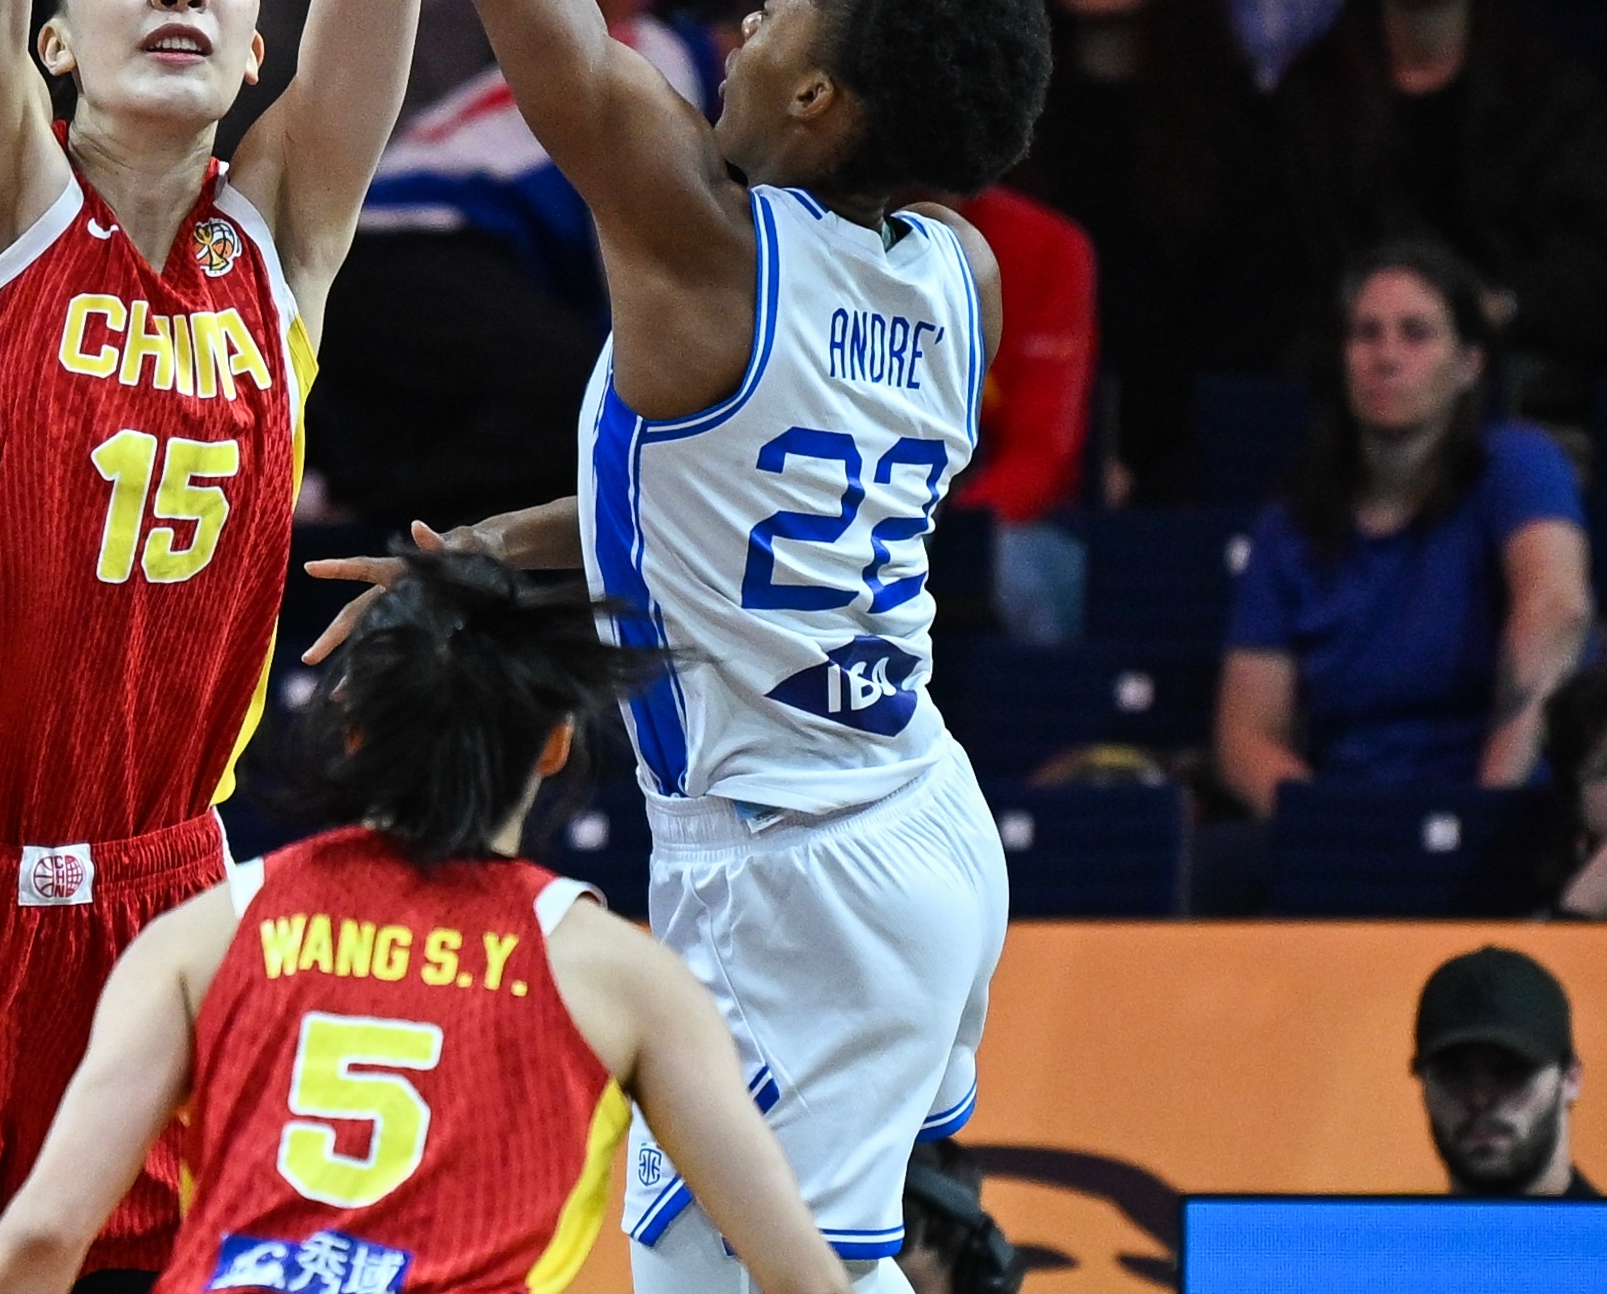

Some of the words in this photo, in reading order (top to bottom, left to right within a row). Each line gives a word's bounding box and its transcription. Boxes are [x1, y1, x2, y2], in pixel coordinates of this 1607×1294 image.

[58, 293, 273, 402] CHINA
[91, 428, 240, 584] 15
[741, 426, 950, 614] 22
[260, 913, 413, 981] WANG
[276, 1010, 444, 1209] 5
